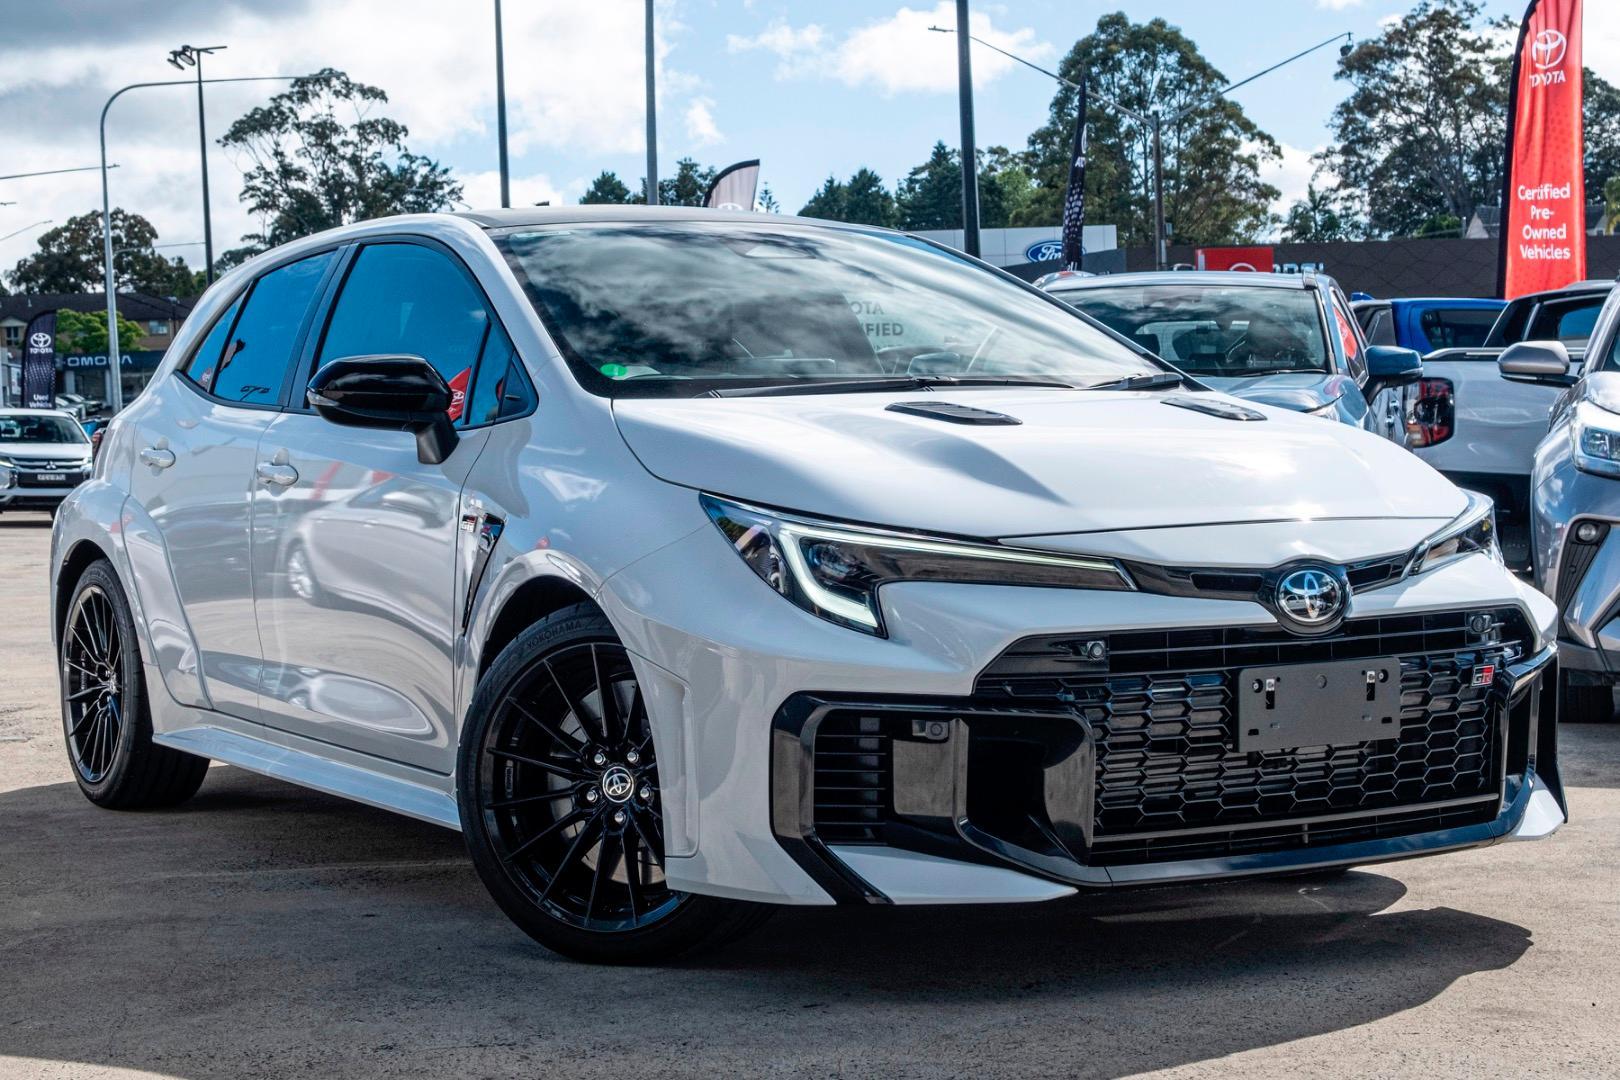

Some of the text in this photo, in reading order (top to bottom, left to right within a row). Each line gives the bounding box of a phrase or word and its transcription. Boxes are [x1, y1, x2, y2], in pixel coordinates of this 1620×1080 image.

[1518, 182, 1570, 200] Certified
[1530, 205, 1555, 220] Pre-
[1522, 223, 1567, 240] Owned
[1519, 244, 1571, 260] Vehicles
[67, 354, 133, 367] OMOA
[527, 620, 582, 649] YOKOHAMA
